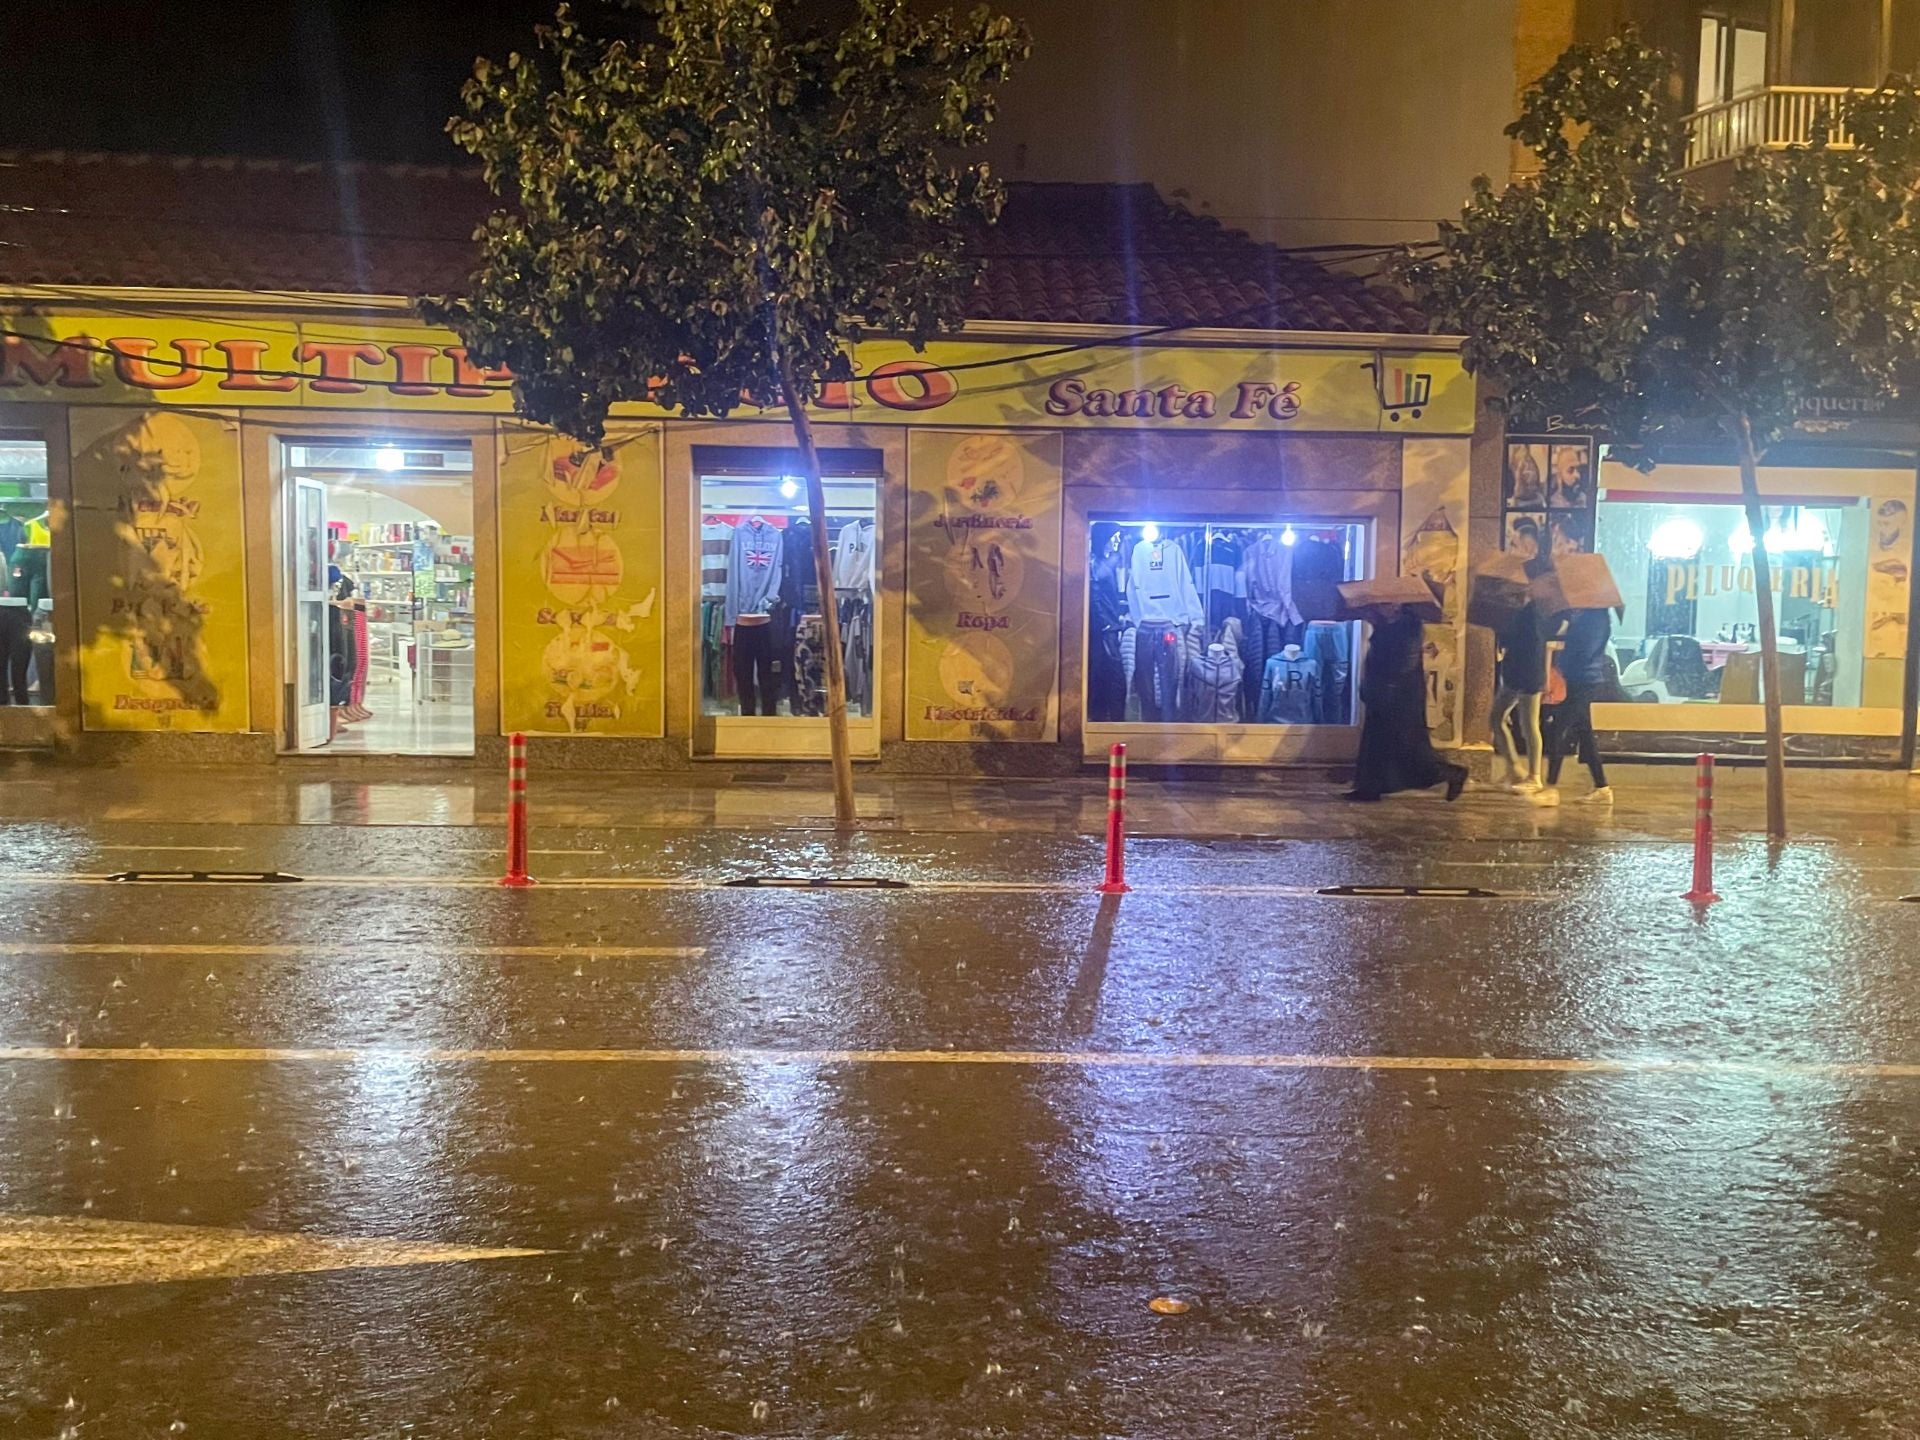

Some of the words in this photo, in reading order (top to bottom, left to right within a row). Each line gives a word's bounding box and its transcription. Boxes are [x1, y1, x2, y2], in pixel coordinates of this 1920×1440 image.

[0, 336, 959, 411] MULTIPIO
[1045, 379, 1217, 419] Santa
[1230, 381, 1302, 421] Fé
[1664, 563, 1841, 609] PELUQERIA
[956, 611, 1010, 632] Ropa
